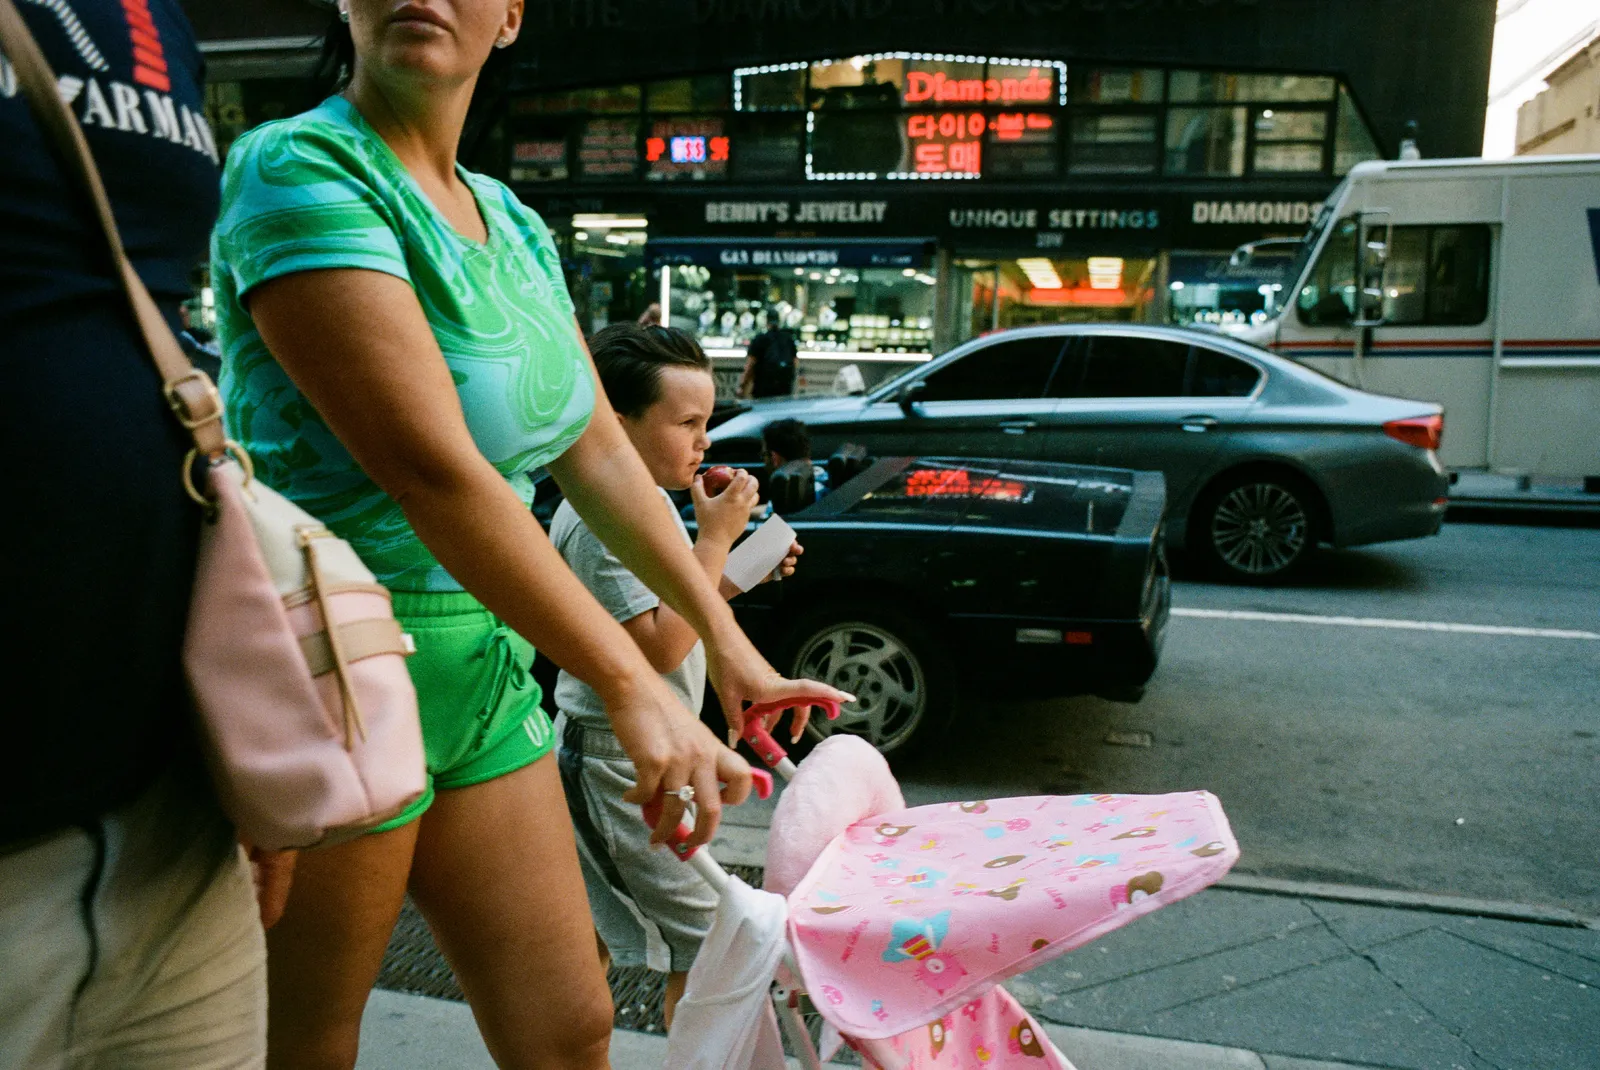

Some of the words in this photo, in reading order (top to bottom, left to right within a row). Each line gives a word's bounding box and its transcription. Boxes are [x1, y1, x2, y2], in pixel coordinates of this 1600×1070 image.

[904, 68, 1052, 102] Diamonds
[915, 140, 981, 173] 도매
[704, 201, 788, 223] BENNY'S
[795, 201, 887, 223] JEWELRY
[949, 209, 1038, 229] UNIQUE
[1048, 209, 1160, 230] SETTINGS
